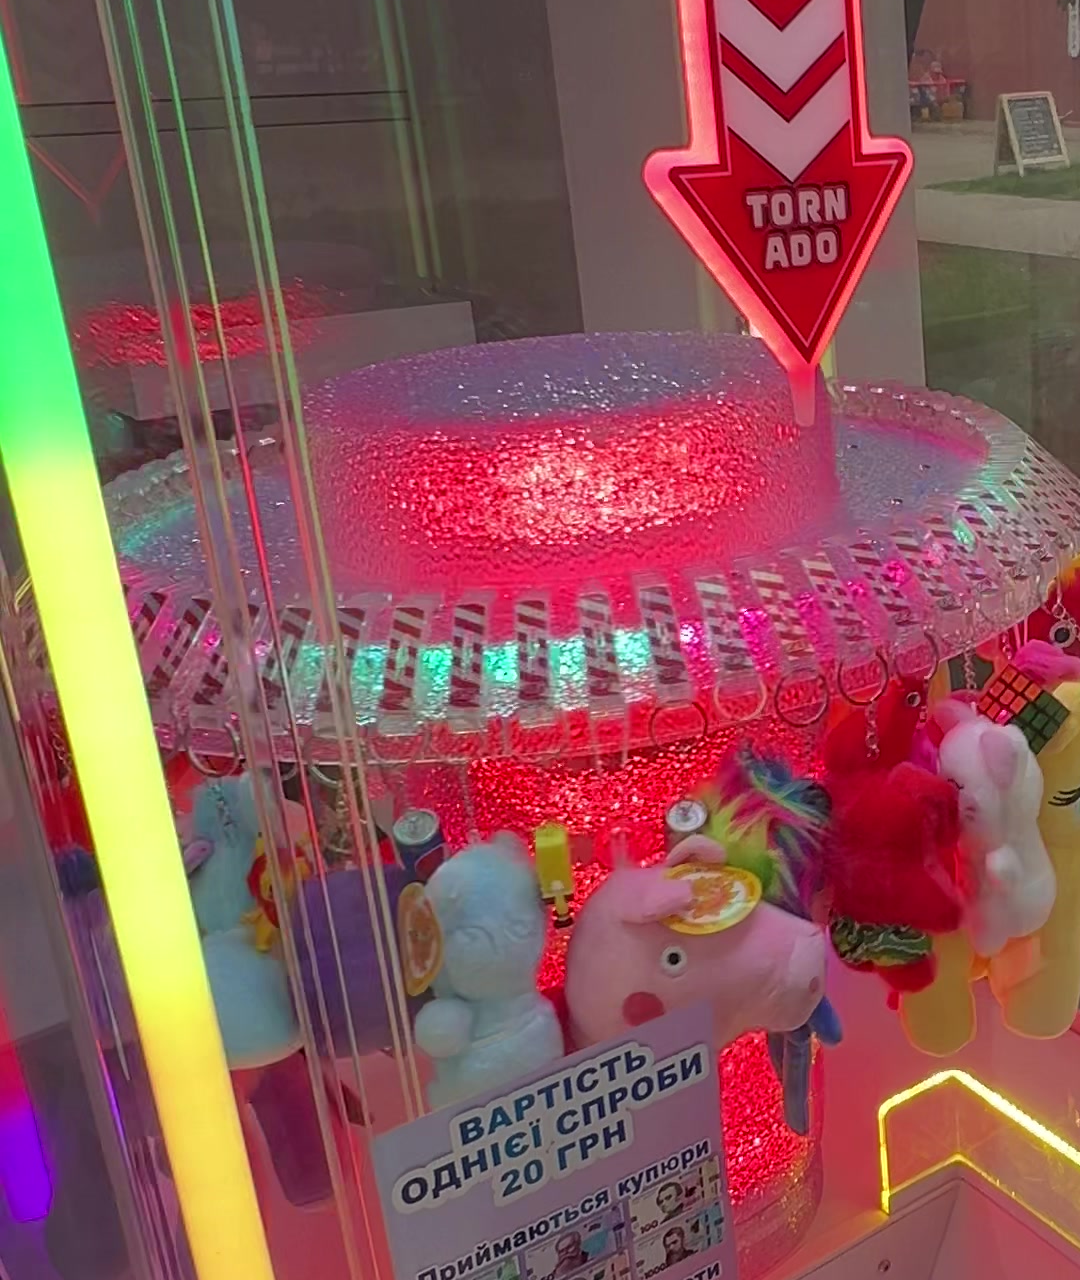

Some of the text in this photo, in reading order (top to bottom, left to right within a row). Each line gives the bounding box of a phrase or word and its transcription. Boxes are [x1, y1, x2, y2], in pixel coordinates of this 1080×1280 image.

[746, 187, 847, 229] TORN
[765, 231, 838, 270] ADO
[459, 1050, 648, 1145] ВАРТІСТЬ
[401, 1052, 702, 1205] ОДНІЄЇ СПРОБИ
[500, 1119, 626, 1198] 20 ГРН
[618, 1140, 709, 1197] купюри
[640, 1219, 659, 1235] 100
